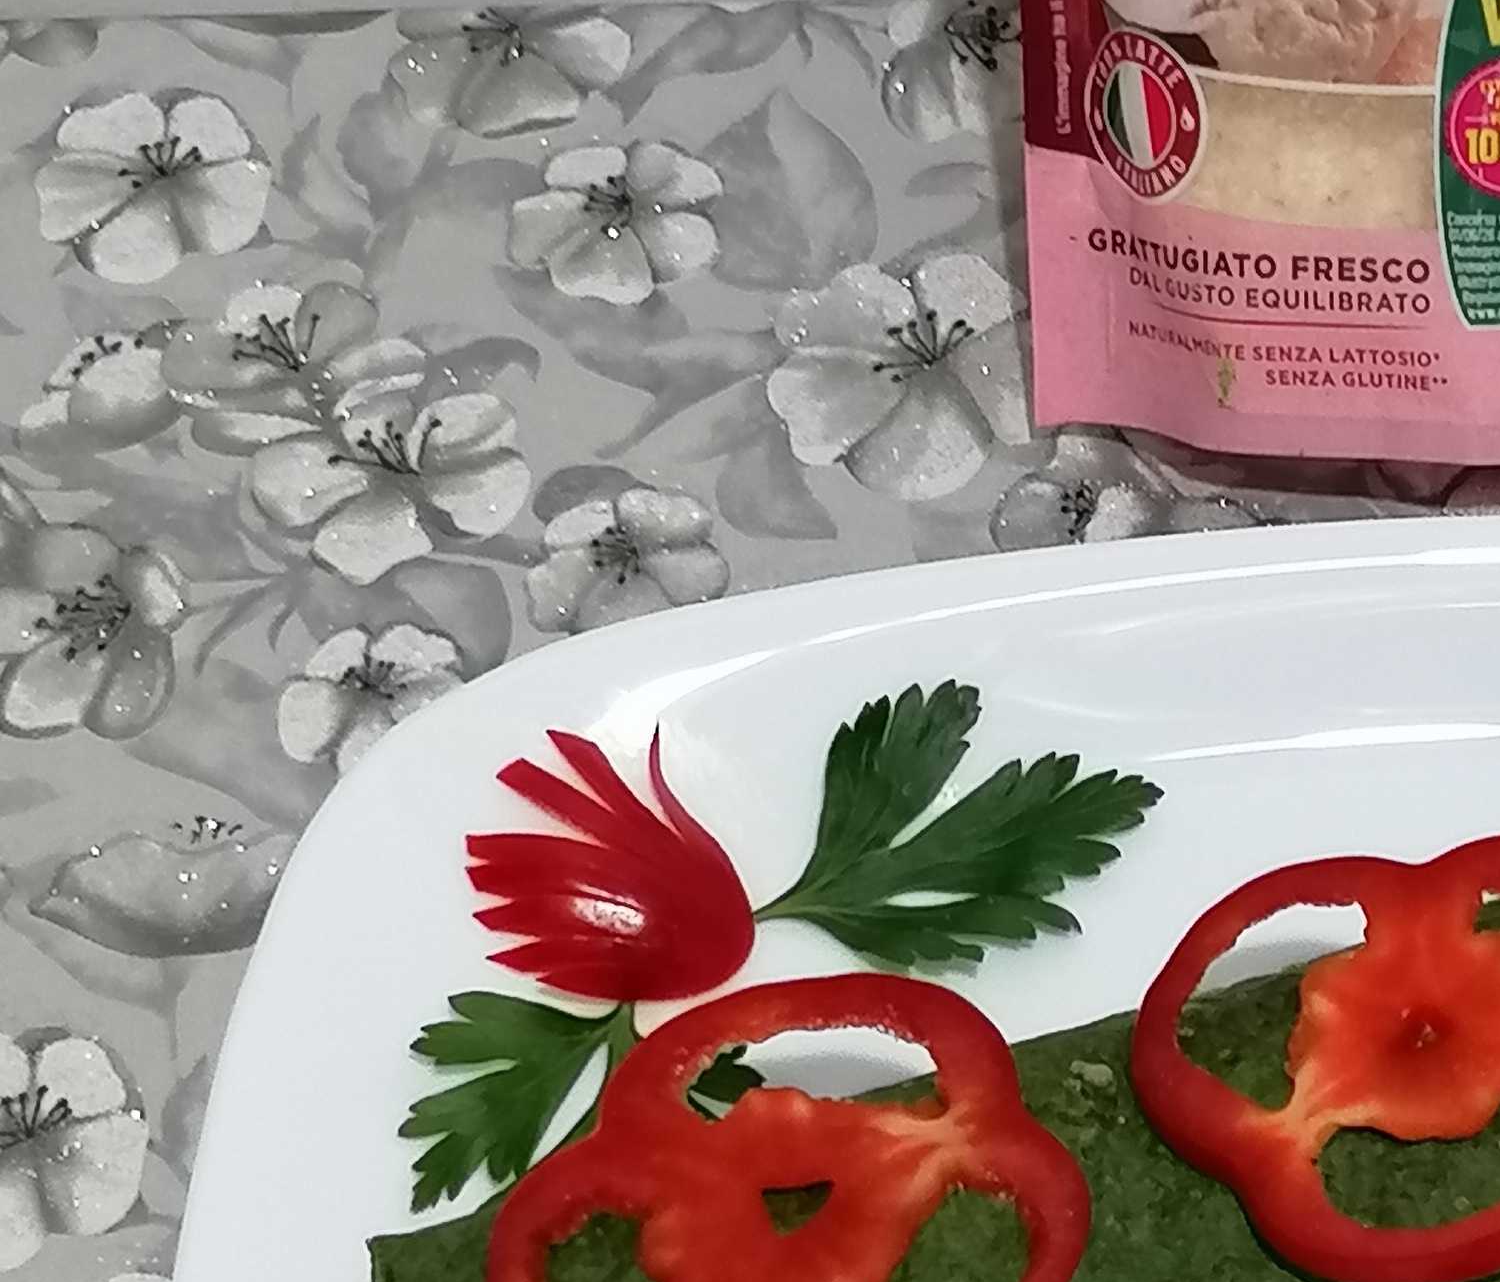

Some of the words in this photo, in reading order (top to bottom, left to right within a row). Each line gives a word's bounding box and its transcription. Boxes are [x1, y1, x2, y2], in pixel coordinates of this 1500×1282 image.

[1123, 34, 1186, 90] LATTE
[1087, 228, 1278, 279] GRATTUGIATO
[1291, 255, 1431, 284] FRESCO
[1129, 267, 1162, 294] DAL
[1165, 278, 1236, 307] GUSTO
[1246, 287, 1431, 315] EQUILIBRATO
[1128, 319, 1246, 362] NATURALMENTE
[1252, 345, 1322, 364] SENZA
[1265, 369, 1337, 388] SENZA
